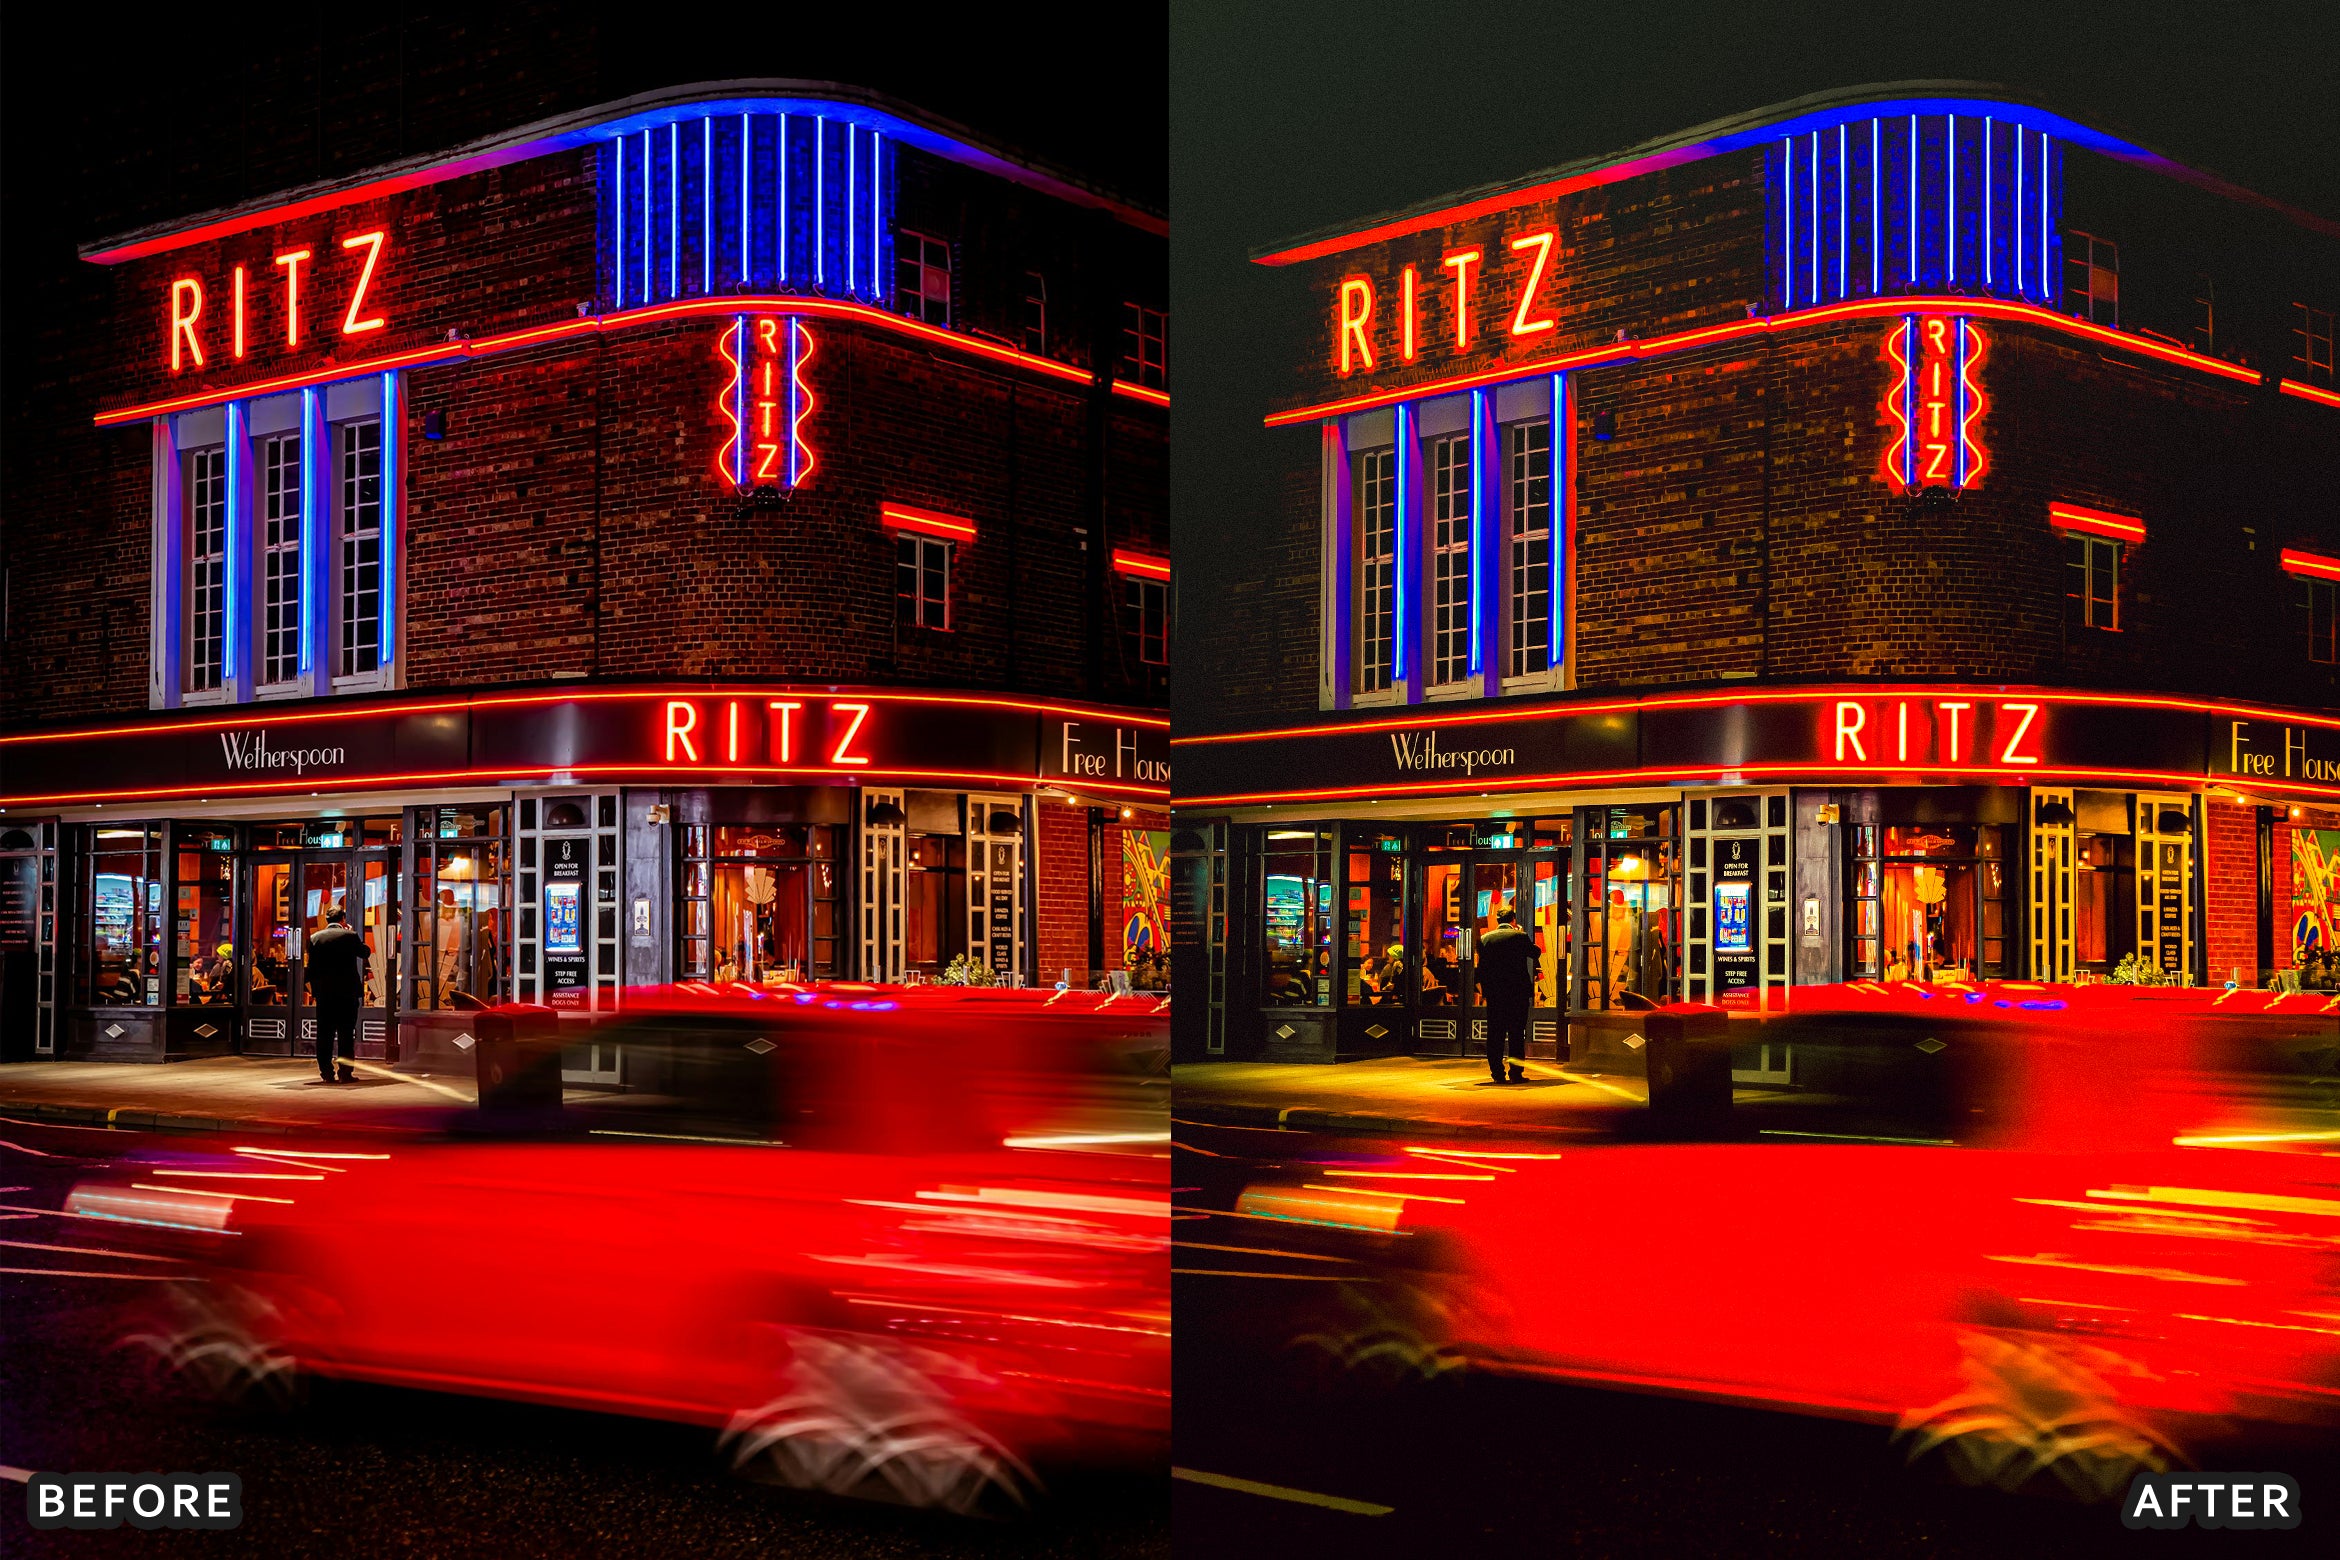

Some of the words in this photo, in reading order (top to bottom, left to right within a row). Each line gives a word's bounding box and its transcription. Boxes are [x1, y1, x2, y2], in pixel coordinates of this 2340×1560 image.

[172, 230, 385, 371] RITZ
[1341, 231, 1554, 373] RITZ
[757, 319, 778, 478] RITZ
[1926, 319, 1947, 478] RITZ
[220, 729, 344, 775] Wetherspoon
[666, 701, 870, 765] RITZ
[1062, 722, 1106, 777] Free
[1116, 728, 1170, 782] Hous
[1390, 730, 1515, 776] Wetherspoon
[1835, 701, 2039, 764] RITZ
[2231, 721, 2275, 776] Free
